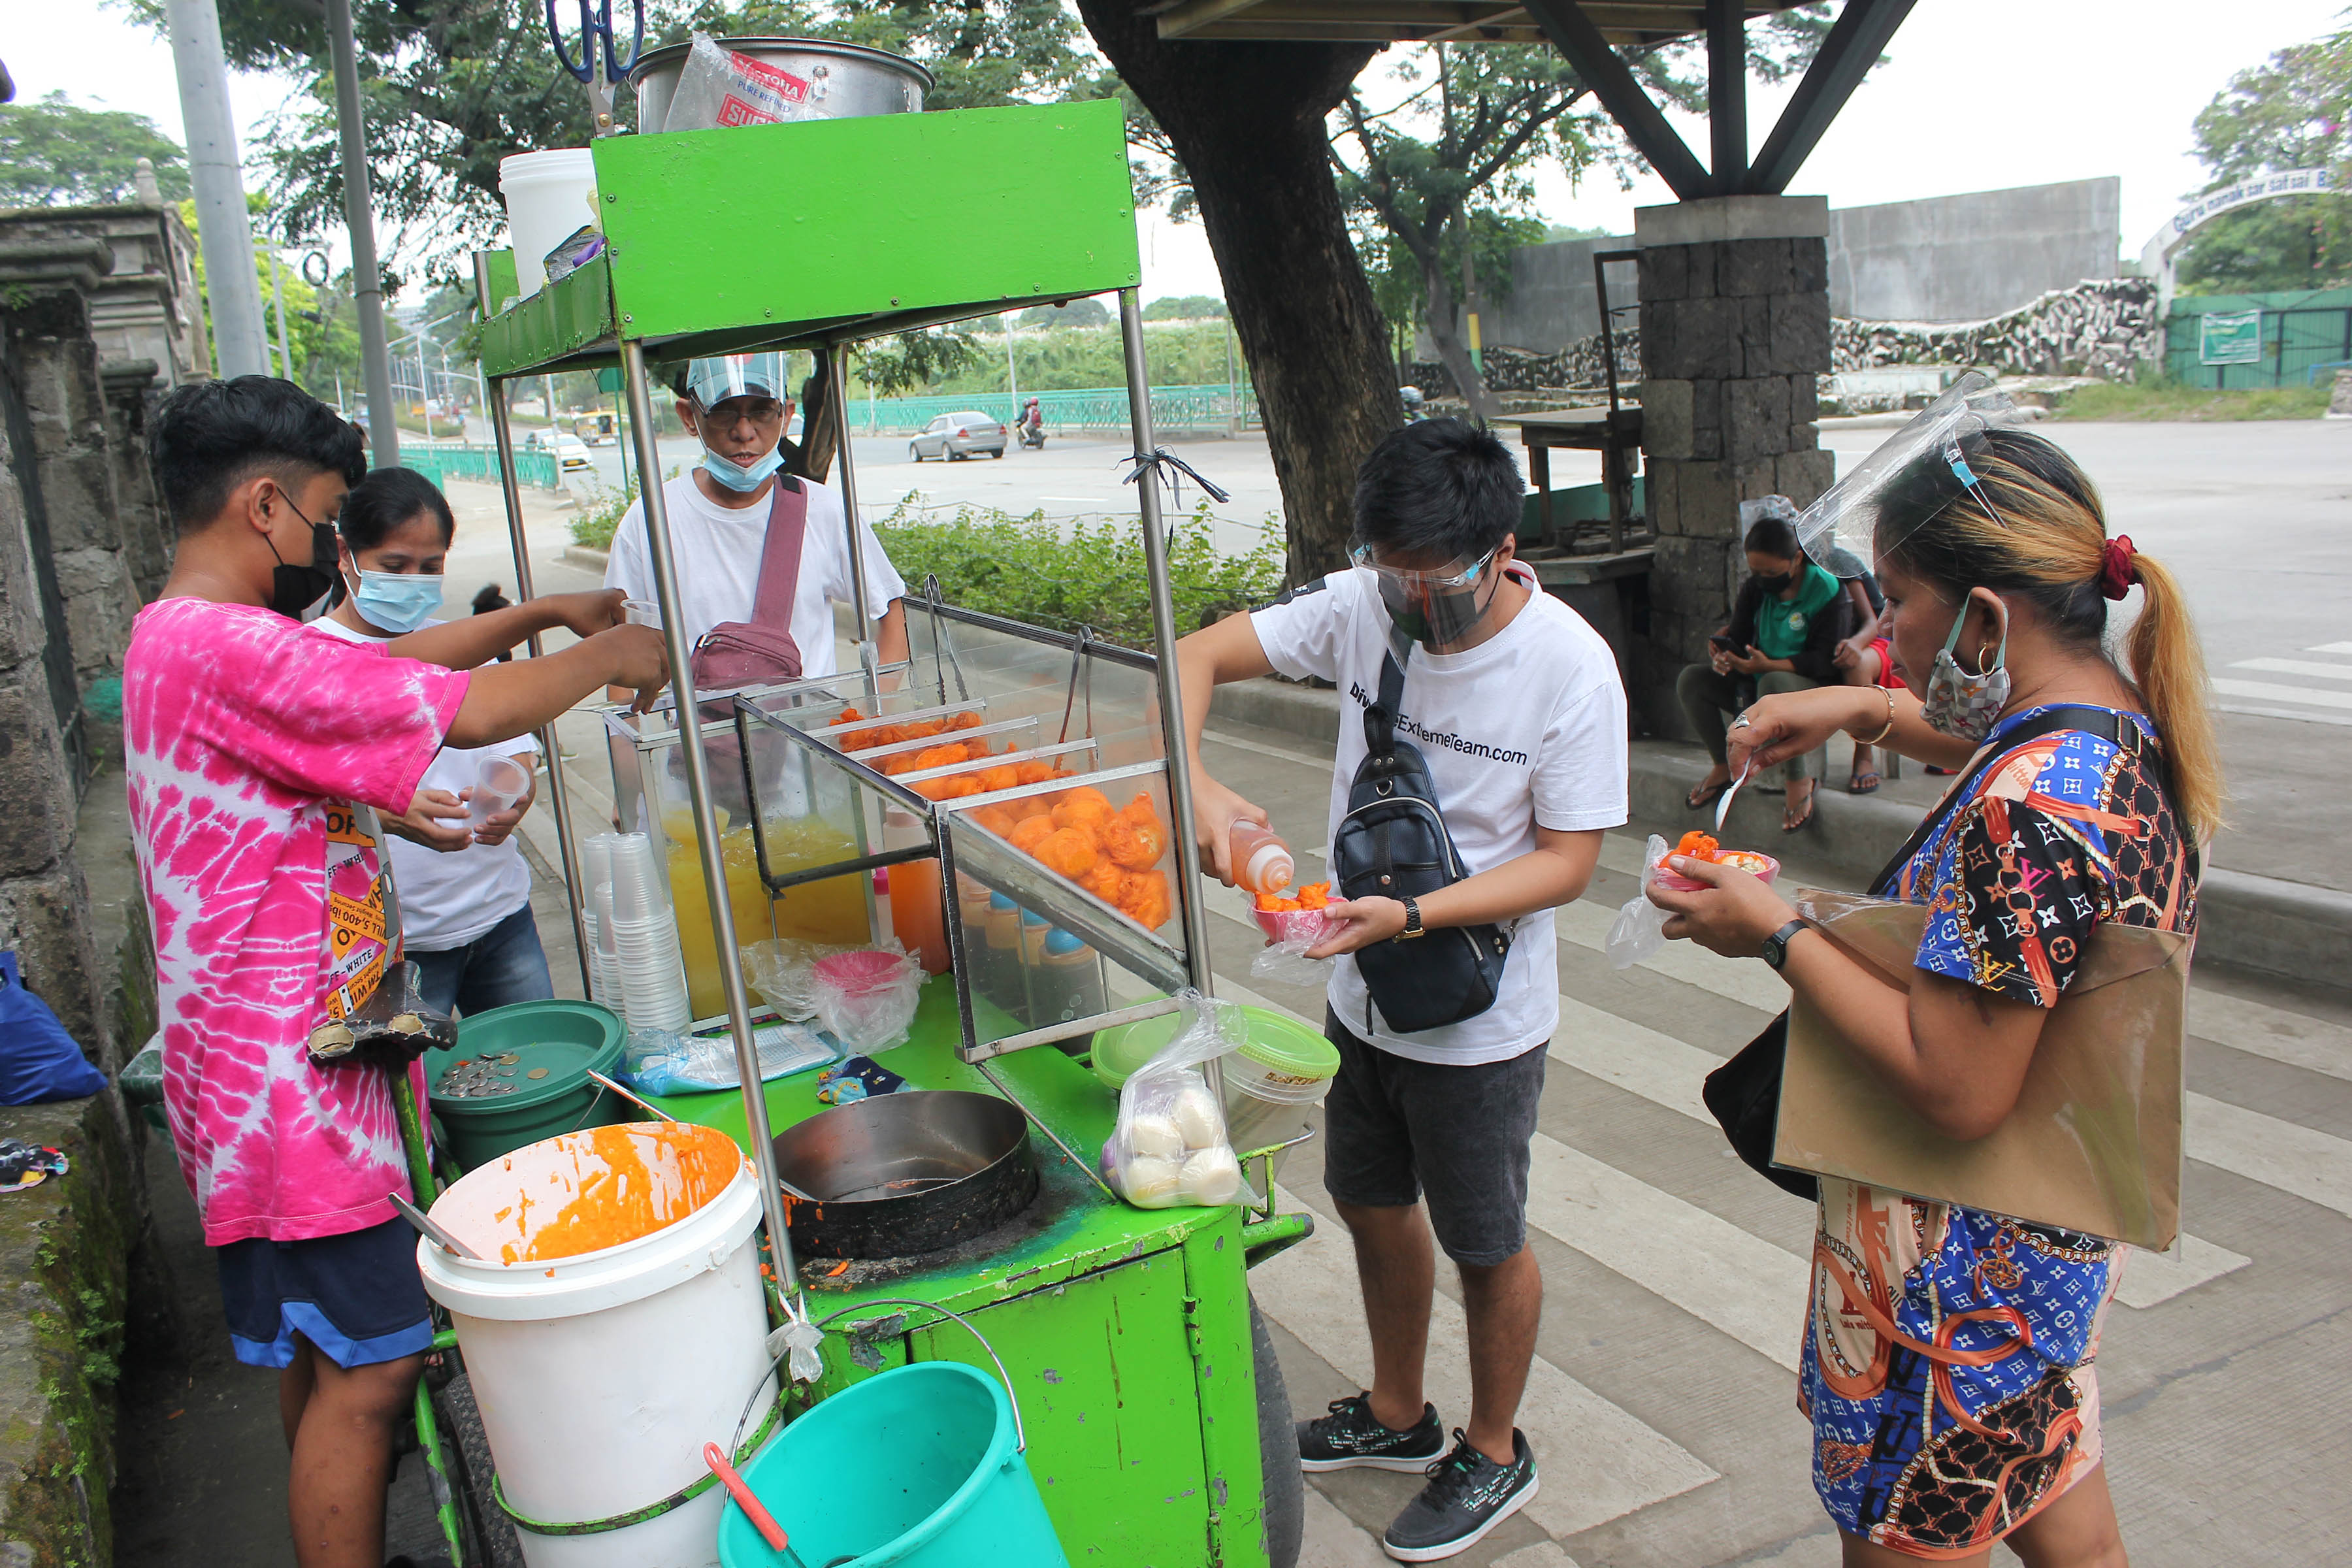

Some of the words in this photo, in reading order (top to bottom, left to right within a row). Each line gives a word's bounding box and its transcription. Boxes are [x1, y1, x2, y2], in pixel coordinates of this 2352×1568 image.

[738, 80, 758, 97] PURE
[759, 91, 791, 113] REFINED
[2174, 204, 2205, 232] Guru
[2247, 183, 2265, 196] sar
[343, 911, 370, 930] 5,400
